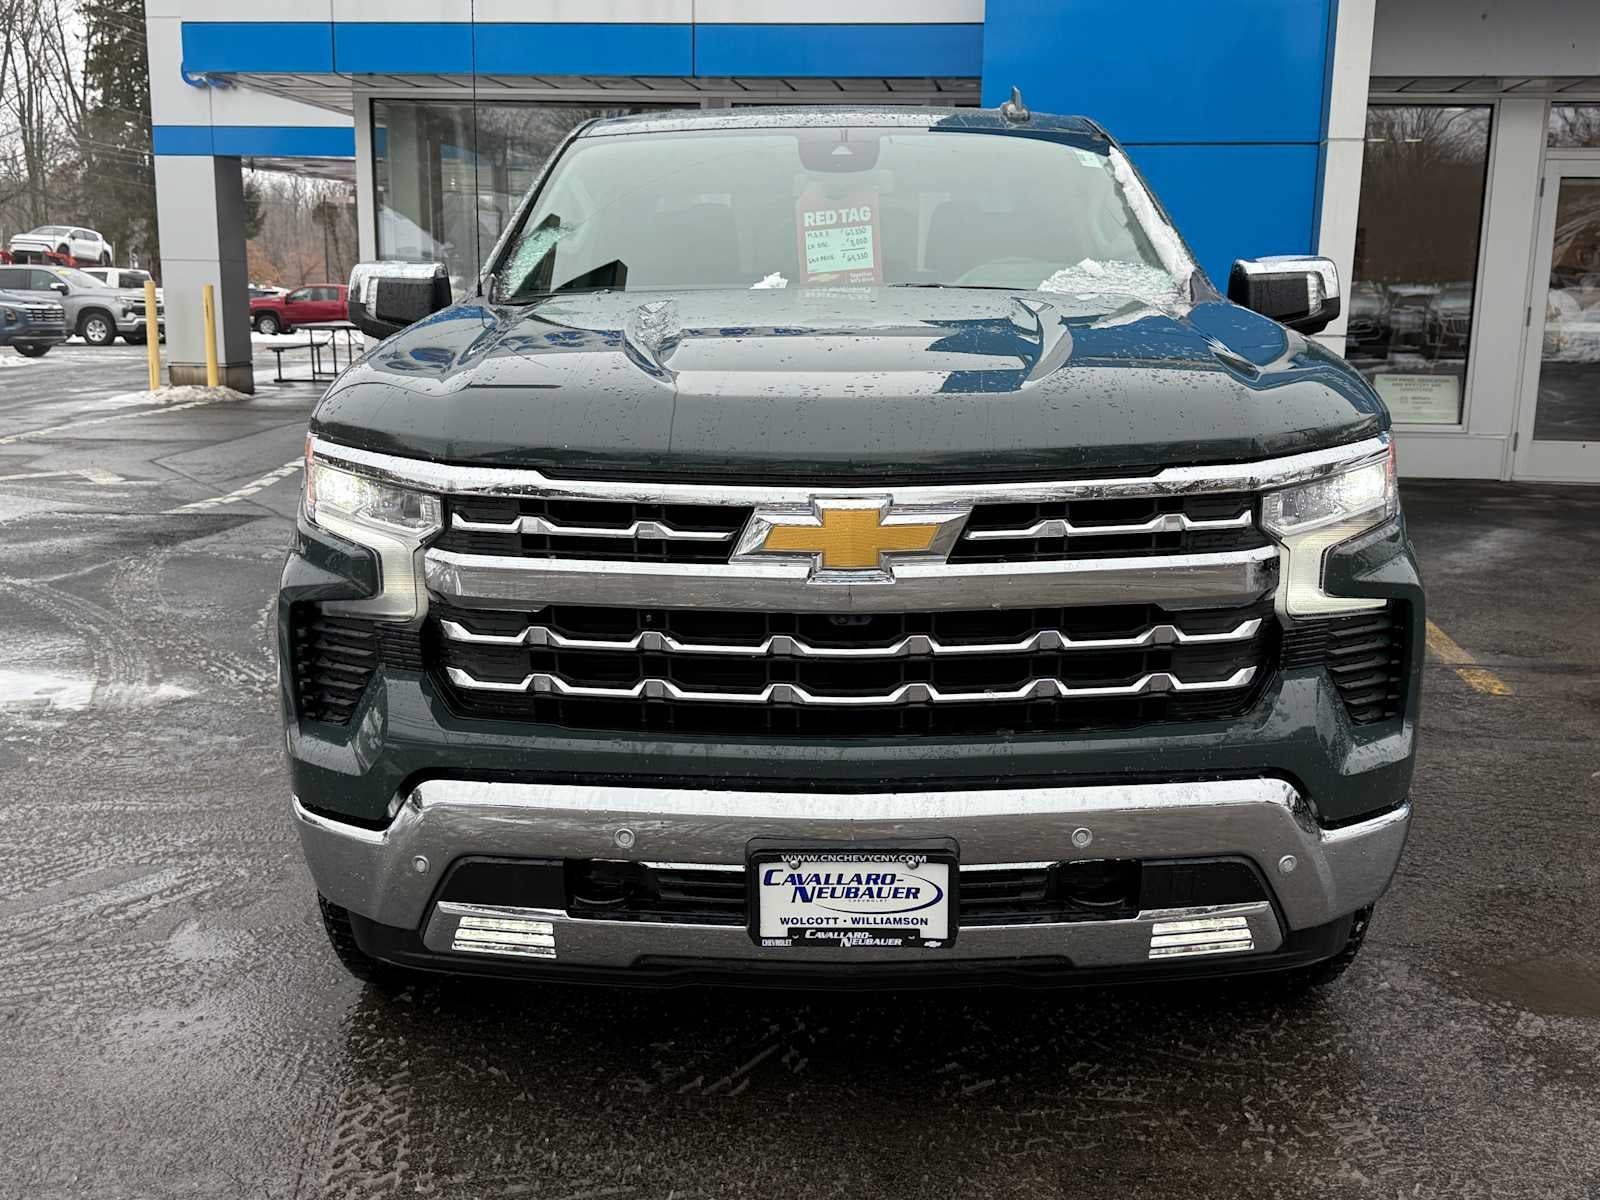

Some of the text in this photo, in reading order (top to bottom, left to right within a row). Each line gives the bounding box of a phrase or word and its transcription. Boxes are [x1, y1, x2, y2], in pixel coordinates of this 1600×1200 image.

[803, 206, 872, 227] RED TAG
[781, 854, 927, 863] WWW.CNCHEVYCNY.COM
[763, 869, 904, 886] CAVALLARO-
[791, 886, 921, 903] NEUBAUER
[780, 917, 928, 926] WOLCOTT WILLIAMSON
[805, 929, 872, 939] CAVALLARO-
[761, 939, 793, 947] CHEVROLET
[840, 938, 902, 947] NEUBAUER
